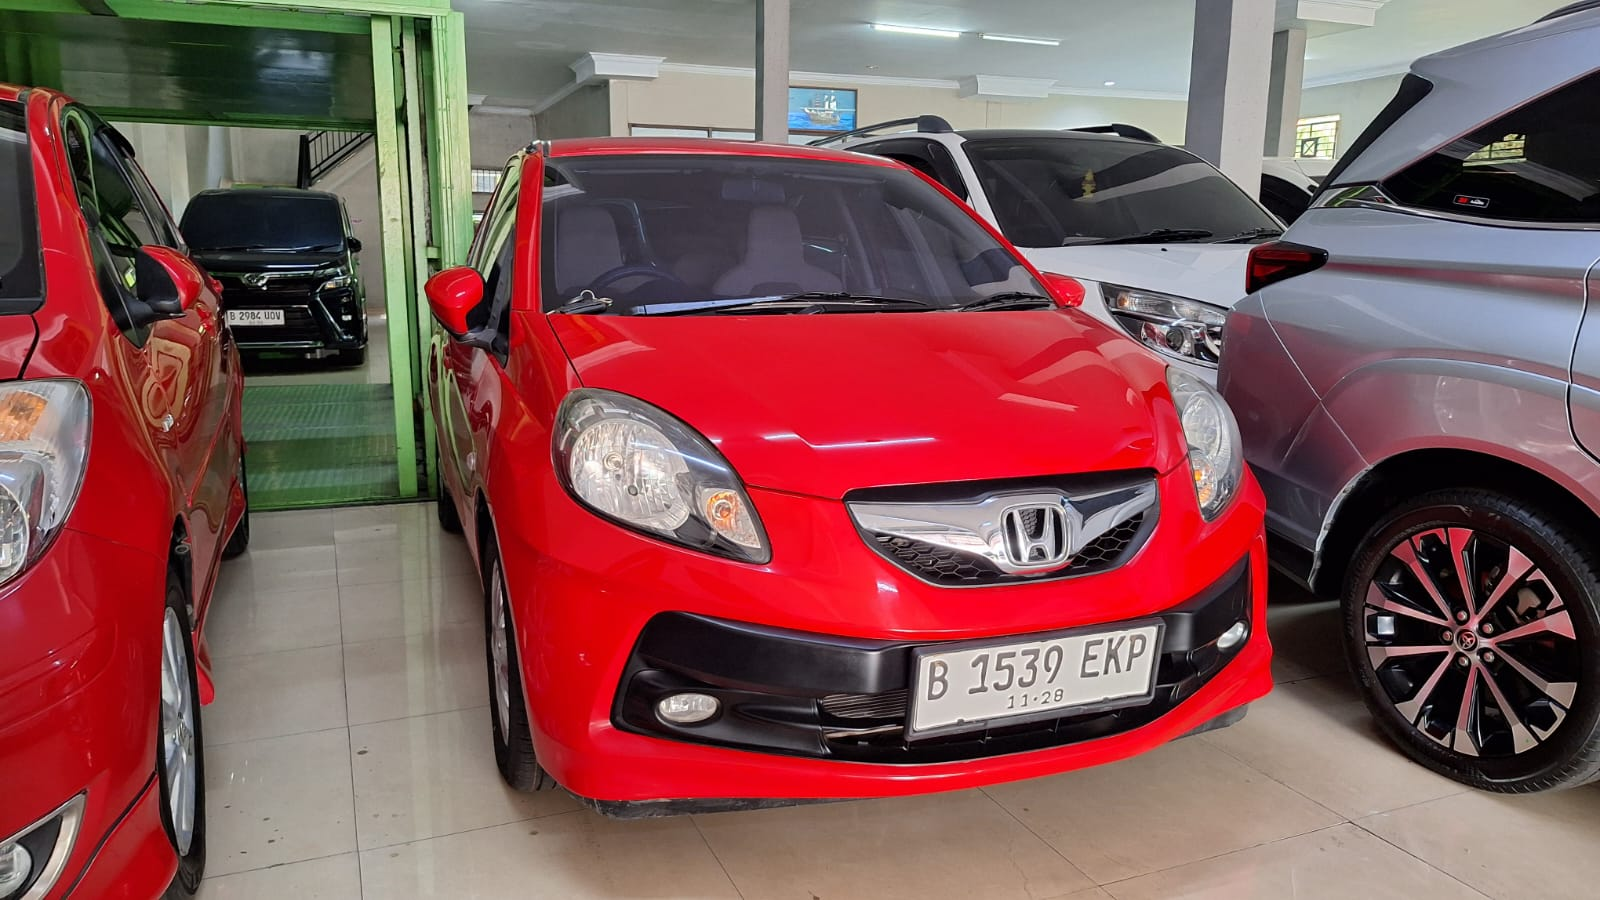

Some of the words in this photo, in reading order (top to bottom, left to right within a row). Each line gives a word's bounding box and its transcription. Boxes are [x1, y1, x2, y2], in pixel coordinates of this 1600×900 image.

[230, 311, 236, 321] B
[927, 660, 949, 701] B
[968, 644, 1064, 695] 1539
[1080, 633, 1147, 678] EKP
